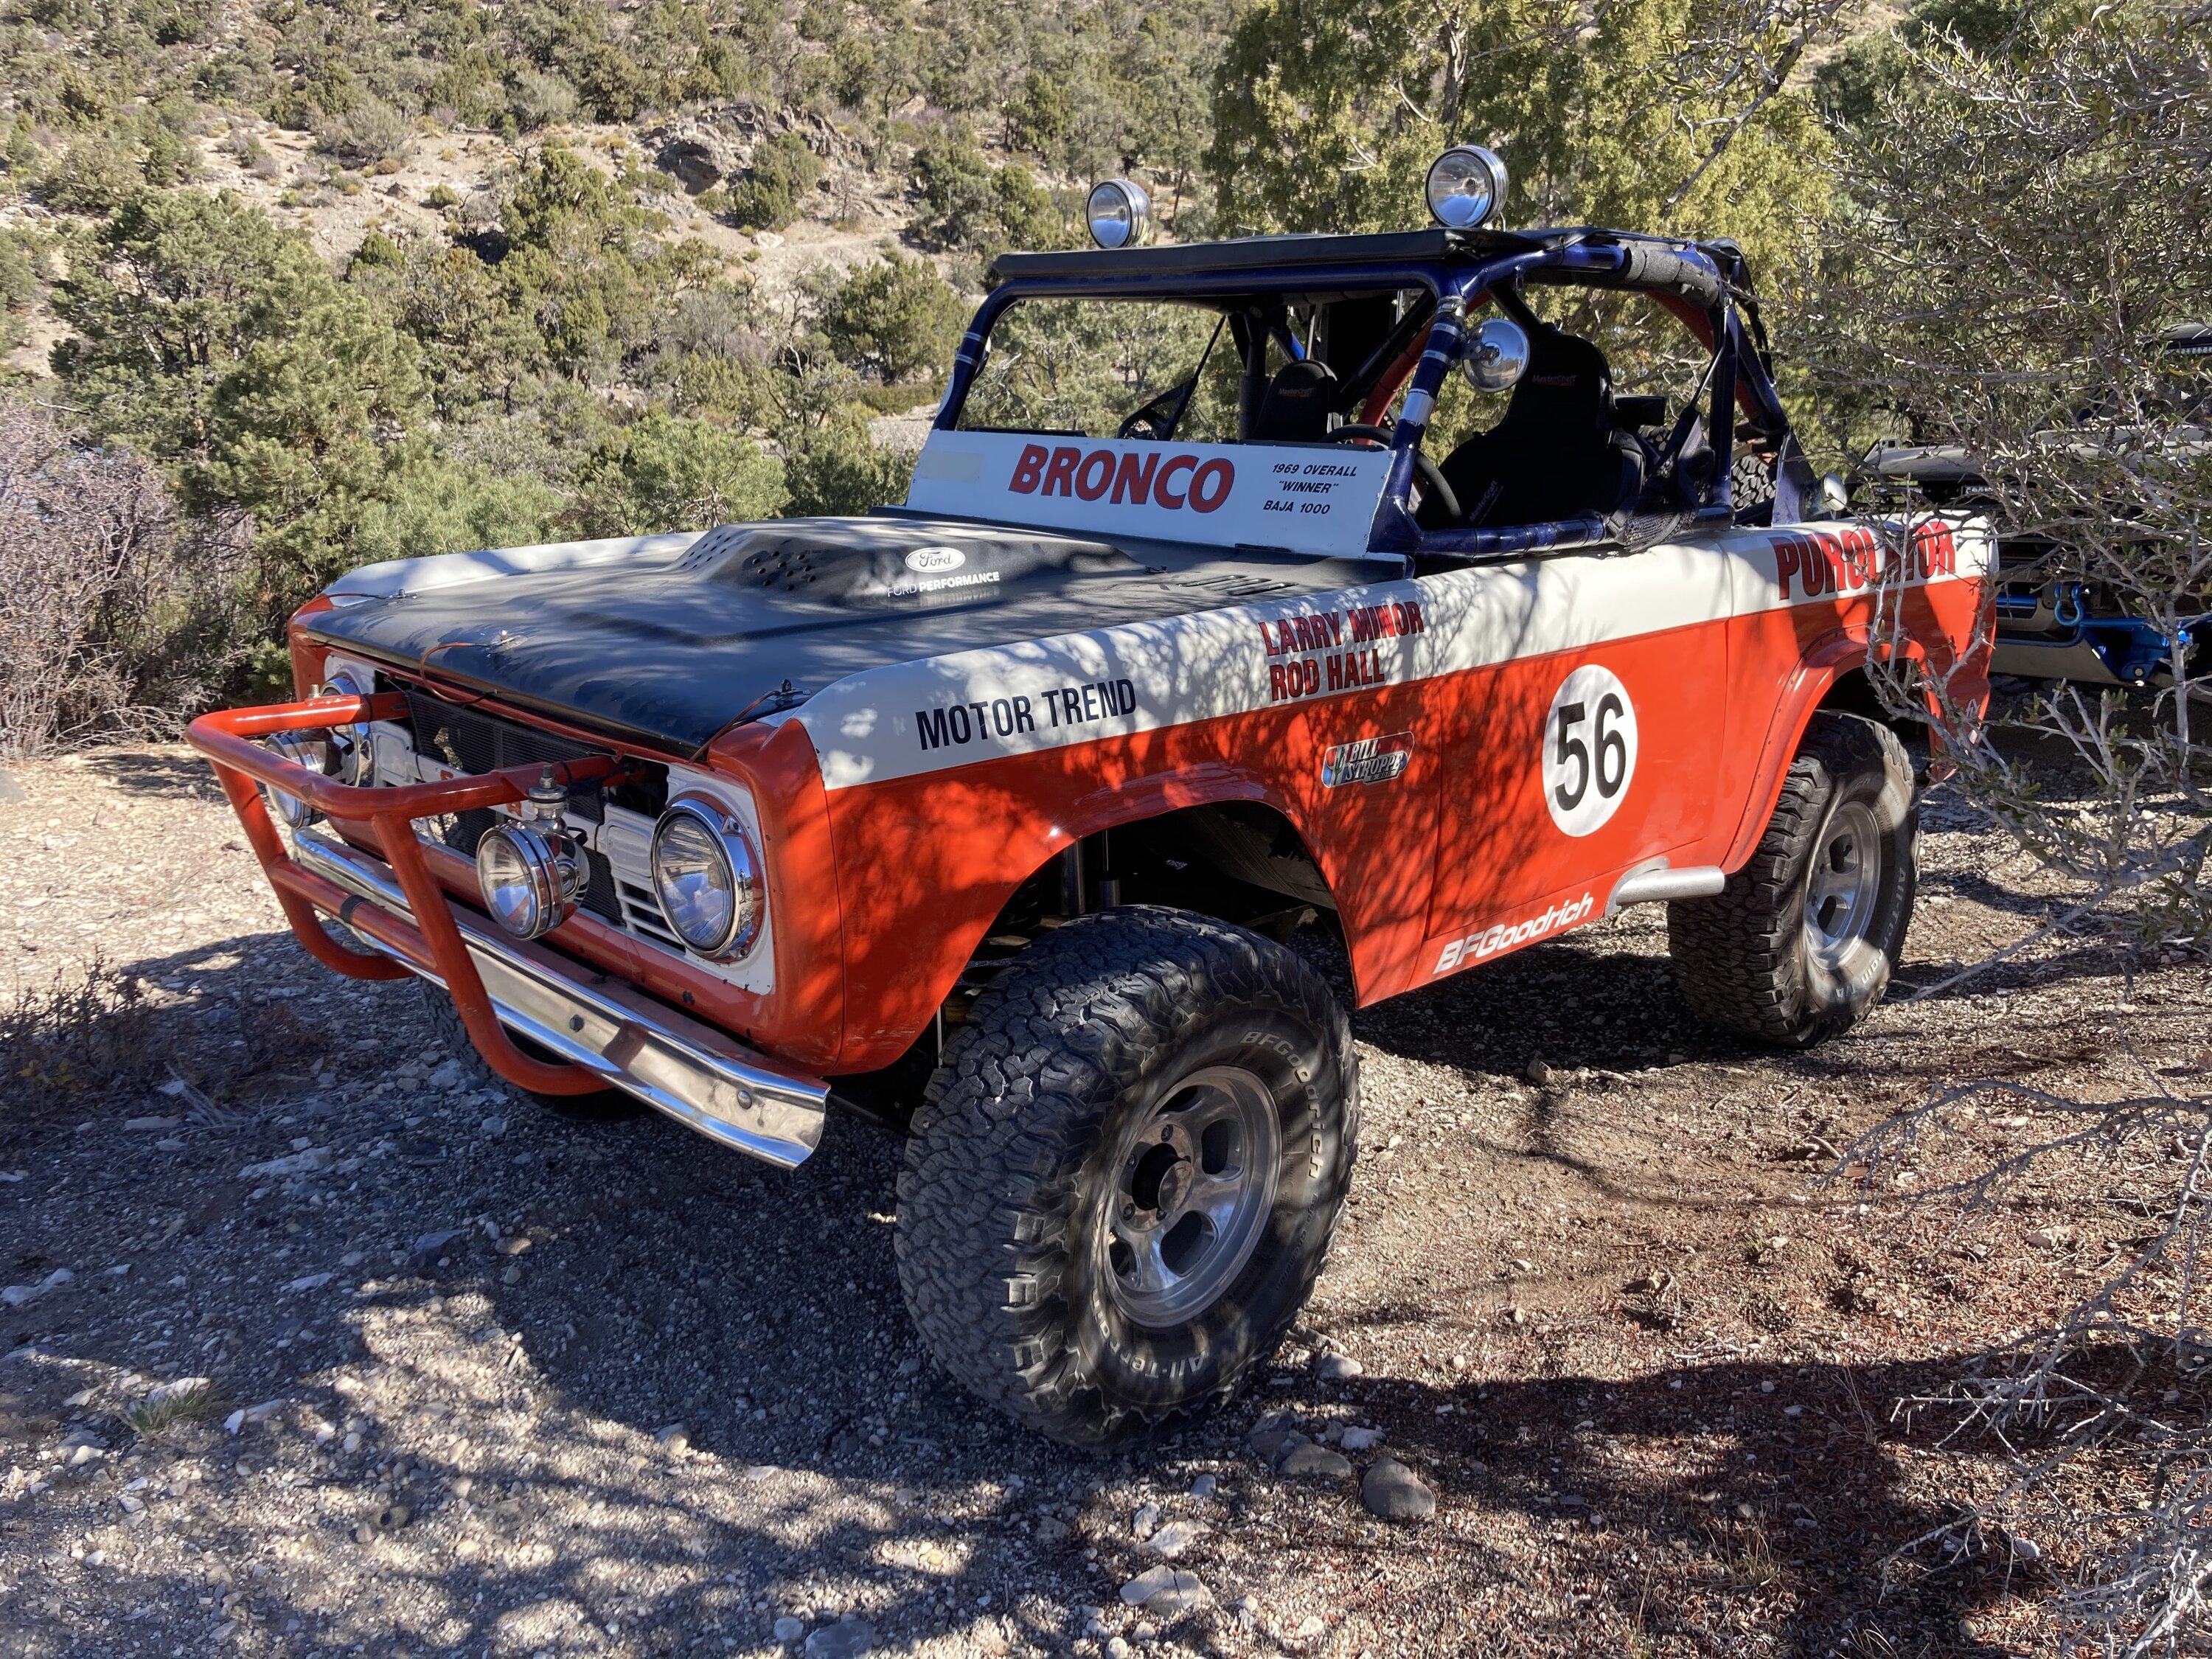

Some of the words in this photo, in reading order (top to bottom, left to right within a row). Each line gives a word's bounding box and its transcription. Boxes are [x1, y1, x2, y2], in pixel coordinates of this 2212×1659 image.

[1008, 443, 1235, 513] BRONCO
[1272, 463, 1299, 473] 1969
[1303, 465, 1357, 477] OVERALL
[1279, 480, 1339, 493] "WINNER"
[1263, 500, 1294, 512] BAJA
[1300, 503, 1330, 514] 1000
[887, 584, 917, 597] FORD
[919, 571, 1001, 592] PERFORMANCE
[919, 552, 953, 567] Ford
[1767, 521, 1956, 600] PUROLOR
[1258, 611, 1342, 656] LARRY
[1346, 601, 1425, 643] MINOR
[1269, 659, 1320, 701] ROD
[1326, 649, 1385, 691] HALL
[915, 695, 1035, 751] MOTOR
[1040, 678, 1136, 728] TREND
[1345, 752, 1404, 781] STROPPE
[1349, 739, 1379, 762] BILL
[1554, 692, 1627, 811] 56
[1433, 891, 1594, 975] BFGoodrich
[1239, 1032, 1324, 1179] BFGoodrich
